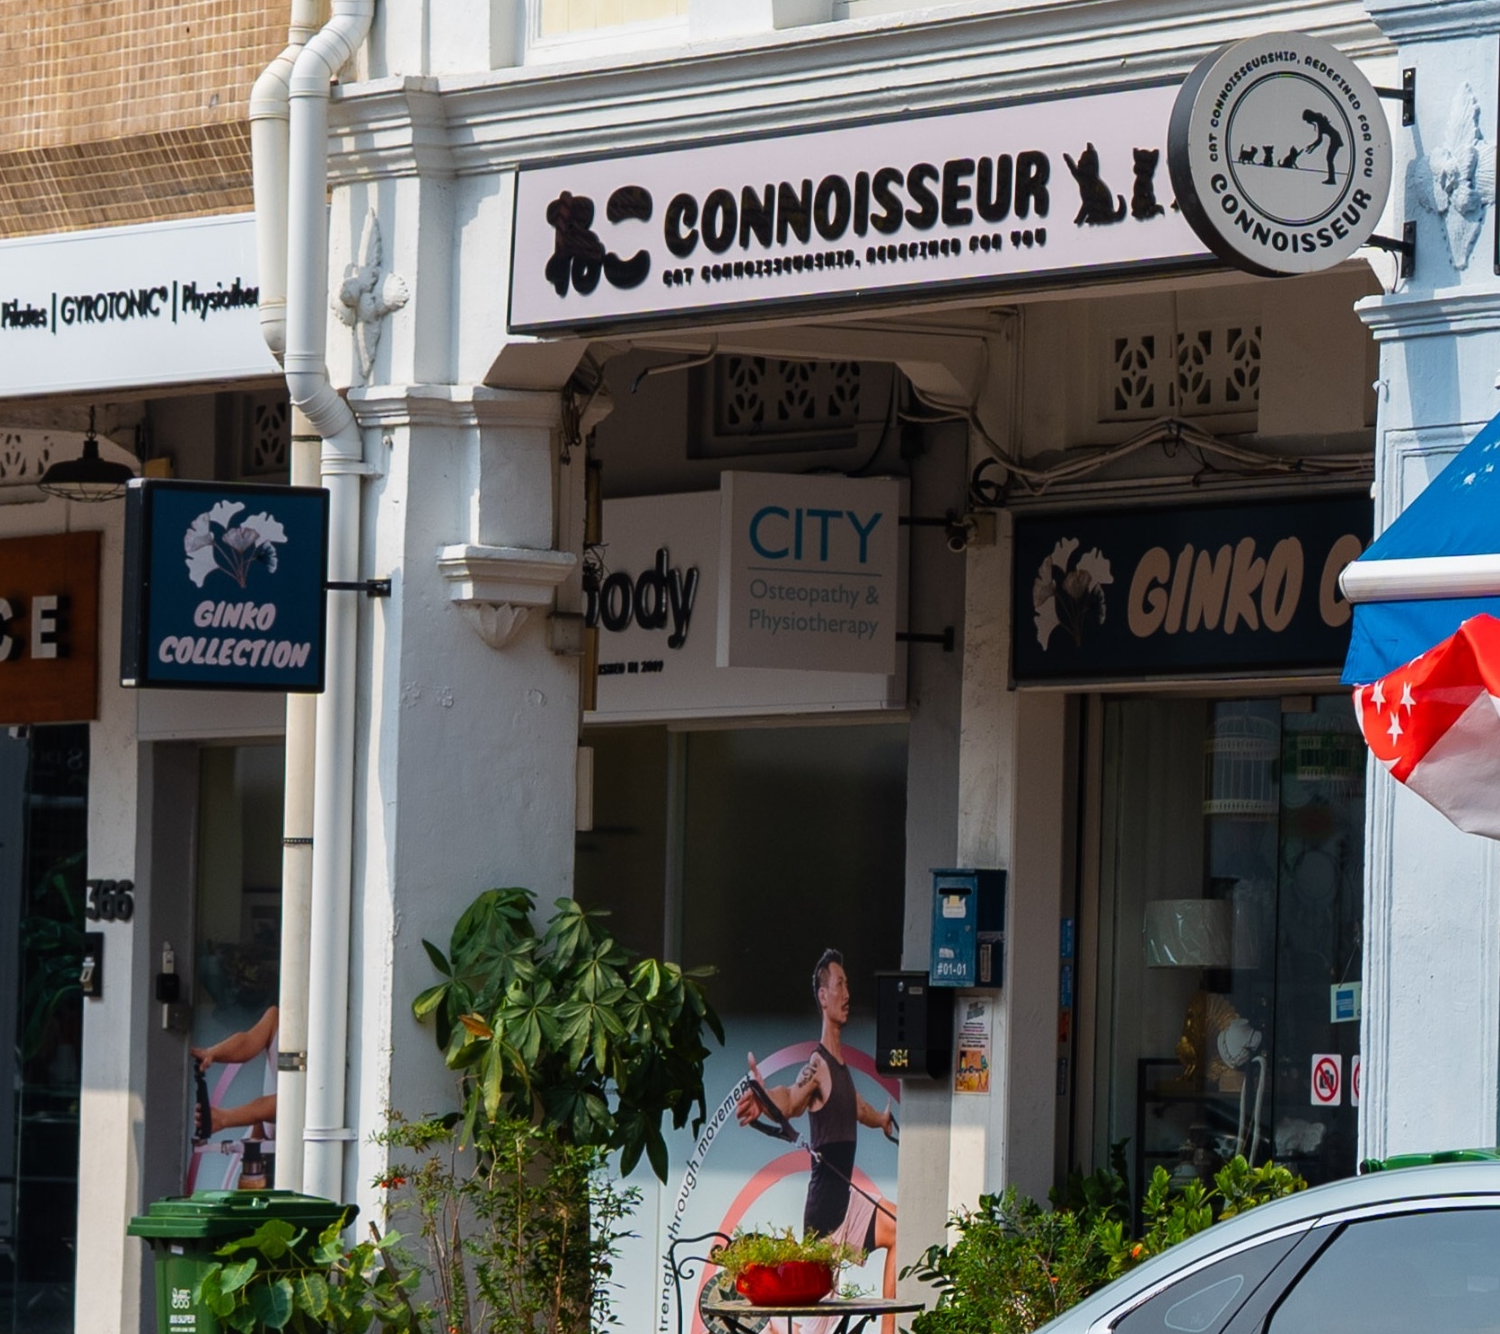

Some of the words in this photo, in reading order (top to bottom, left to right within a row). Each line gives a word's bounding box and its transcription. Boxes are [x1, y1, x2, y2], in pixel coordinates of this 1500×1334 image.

[1208, 132, 1218, 162] CAT
[1304, 55, 1361, 111] REDEFINED
[664, 150, 1051, 259] CONNOISSEUR
[1210, 172, 1372, 254] CONNOISSEUR
[662, 266, 695, 287] CAT
[969, 232, 1002, 255] FOR
[1010, 228, 1047, 250] YOU
[1, 299, 47, 329] Pilates
[749, 505, 883, 564] CITY
[750, 579, 860, 606] Osteopathy
[865, 586, 879, 605] &
[1127, 535, 1303, 639] GINKO
[194, 600, 277, 631] GINKO
[749, 609, 878, 640] Physiotherapy
[158, 635, 311, 669] COLLECTION
[85, 879, 134, 921] 366
[937, 962, 967, 976] #01-01
[668, 1160, 700, 1244] through
